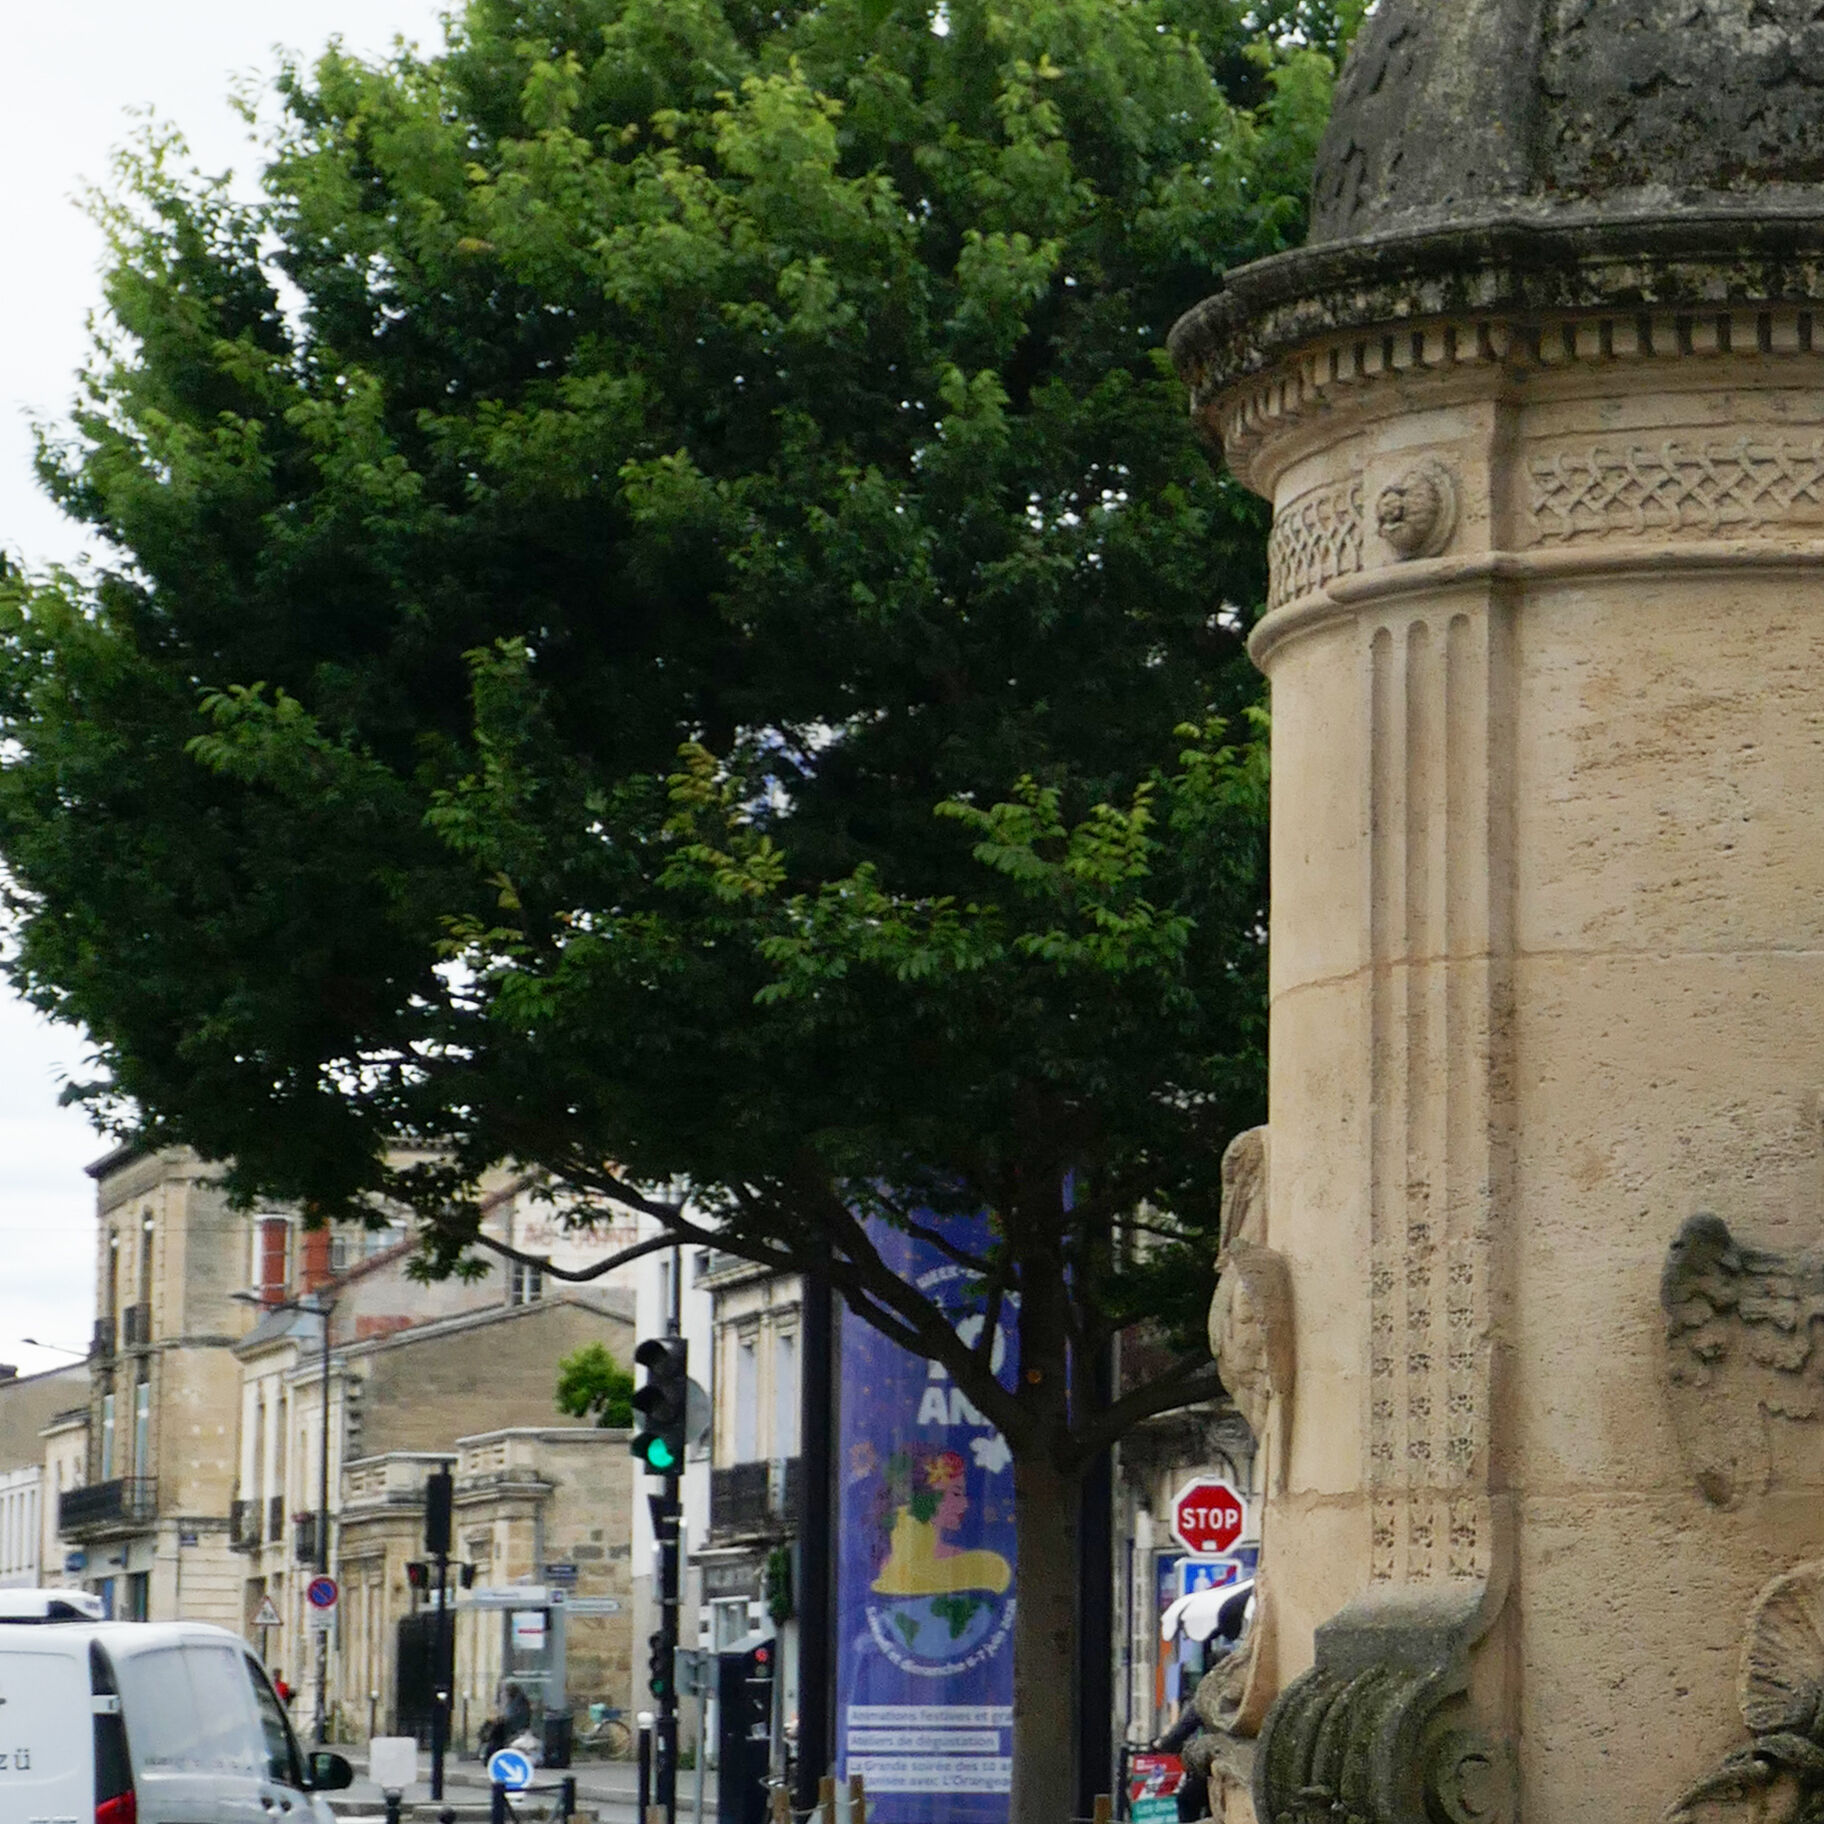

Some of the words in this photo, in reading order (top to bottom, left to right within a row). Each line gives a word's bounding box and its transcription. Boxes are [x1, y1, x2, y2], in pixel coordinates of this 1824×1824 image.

[1182, 1507, 1239, 1530] STOP
[900, 1659, 967, 1677] dimanche
[852, 1709, 917, 1721] Animations
[920, 1709, 970, 1721] festives
[974, 1710, 988, 1721] et
[852, 1735, 893, 1747] Ateliers
[898, 1735, 913, 1747] de
[916, 1735, 994, 1750] dégustation
[850, 1761, 862, 1771] La
[865, 1760, 907, 1772] Grande
[911, 1760, 951, 1772] soirée
[956, 1760, 978, 1772] des
